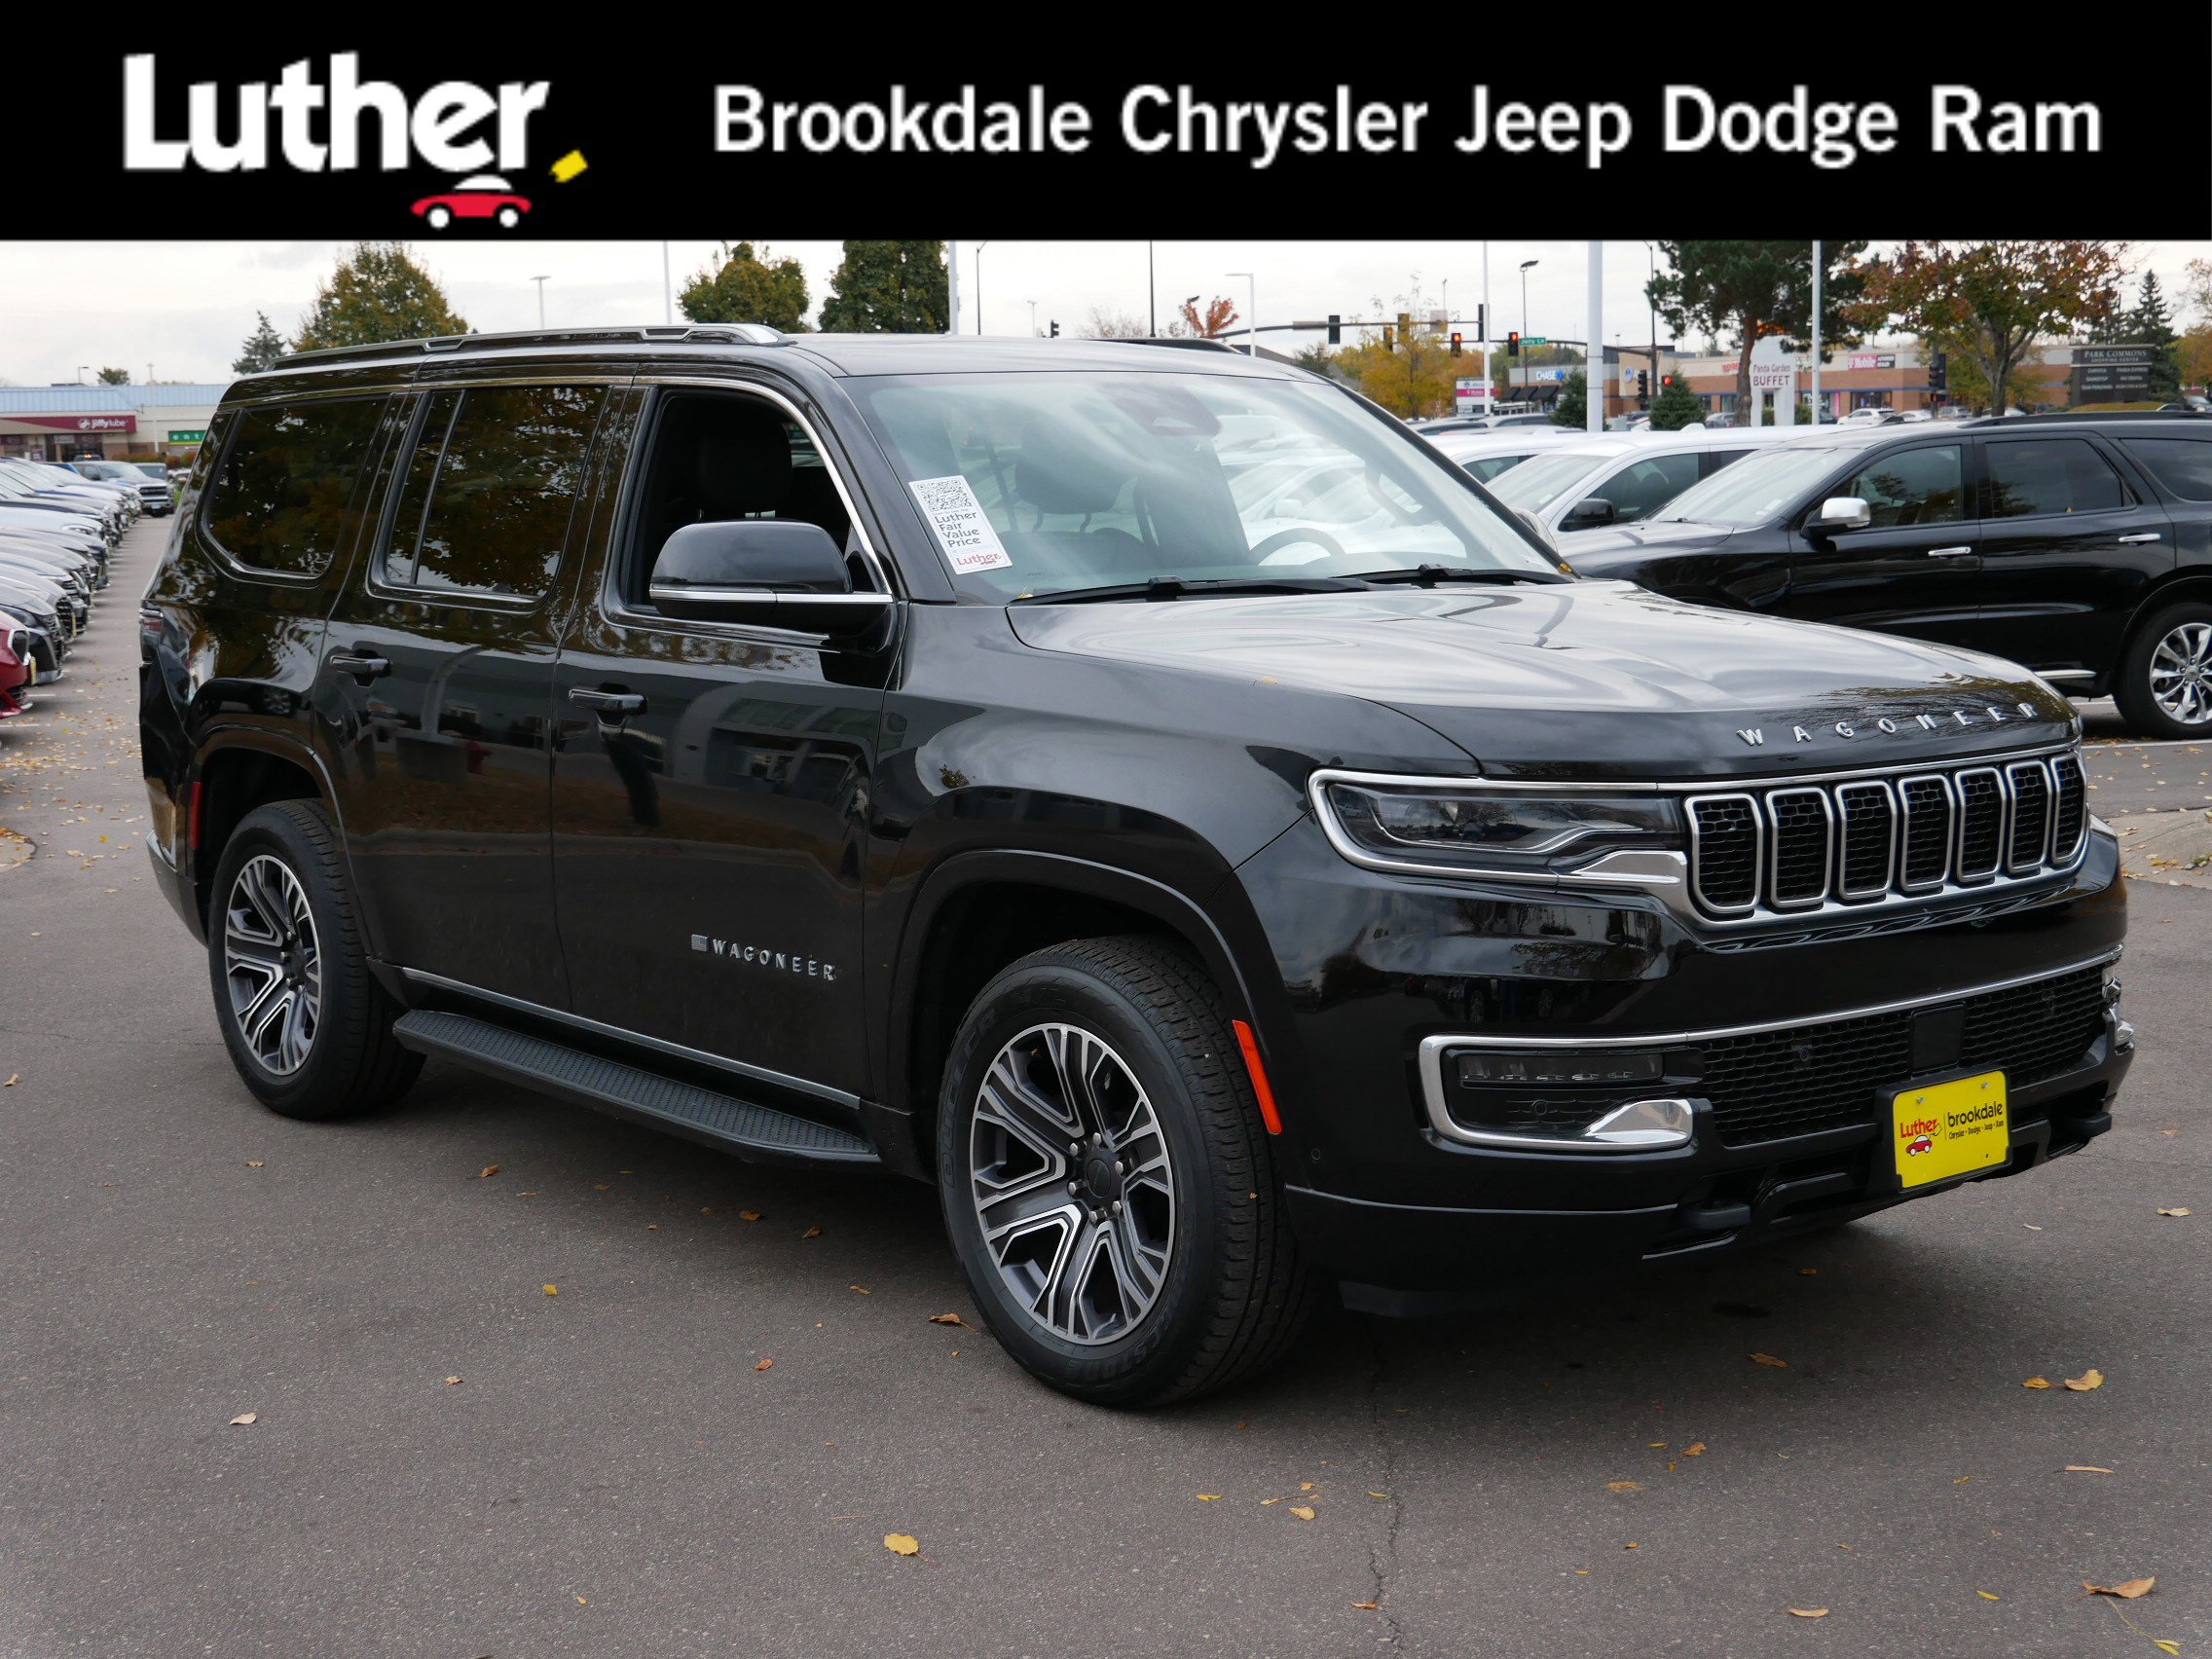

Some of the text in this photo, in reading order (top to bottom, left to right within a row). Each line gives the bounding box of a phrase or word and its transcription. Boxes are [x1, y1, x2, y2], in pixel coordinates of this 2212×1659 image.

[1753, 364, 1770, 373] Panda
[1536, 371, 1557, 381] CHASE
[1753, 376, 1790, 386] BUFFET
[935, 511, 977, 524] Luther
[939, 522, 962, 532] Fair
[942, 529, 980, 539] Value
[947, 537, 981, 547] Price
[956, 552, 1002, 566] Luther
[1737, 702, 2038, 746] WAGONEER
[712, 939, 837, 981] WAGONEER
[1900, 1101, 2003, 1139] Luther brookdale
